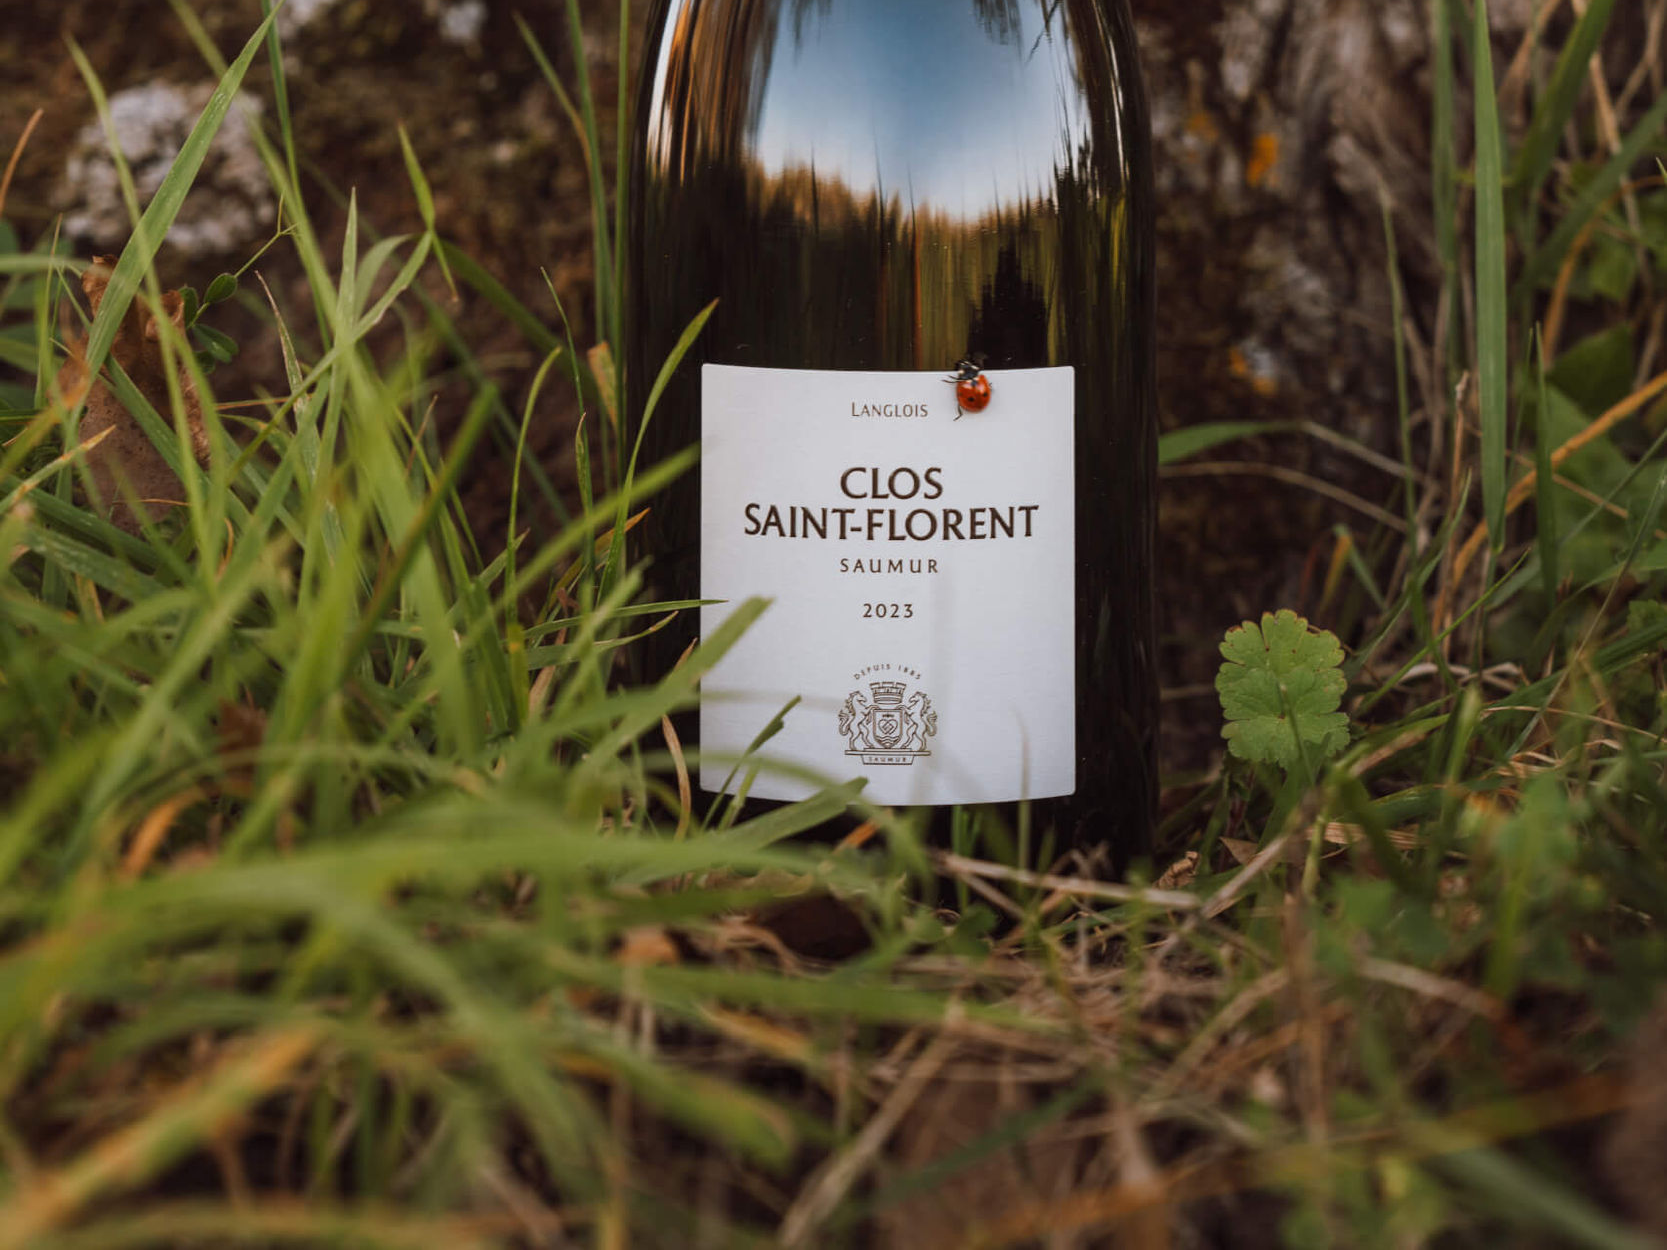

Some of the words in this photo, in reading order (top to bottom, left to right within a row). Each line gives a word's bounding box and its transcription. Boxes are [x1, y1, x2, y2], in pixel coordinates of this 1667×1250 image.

[851, 401, 929, 418] LANGLOIS
[839, 466, 944, 500] CLOS
[744, 502, 1040, 542] SAINT-FLORENT
[839, 557, 939, 574] SAUMUR
[862, 602, 914, 619] 2023
